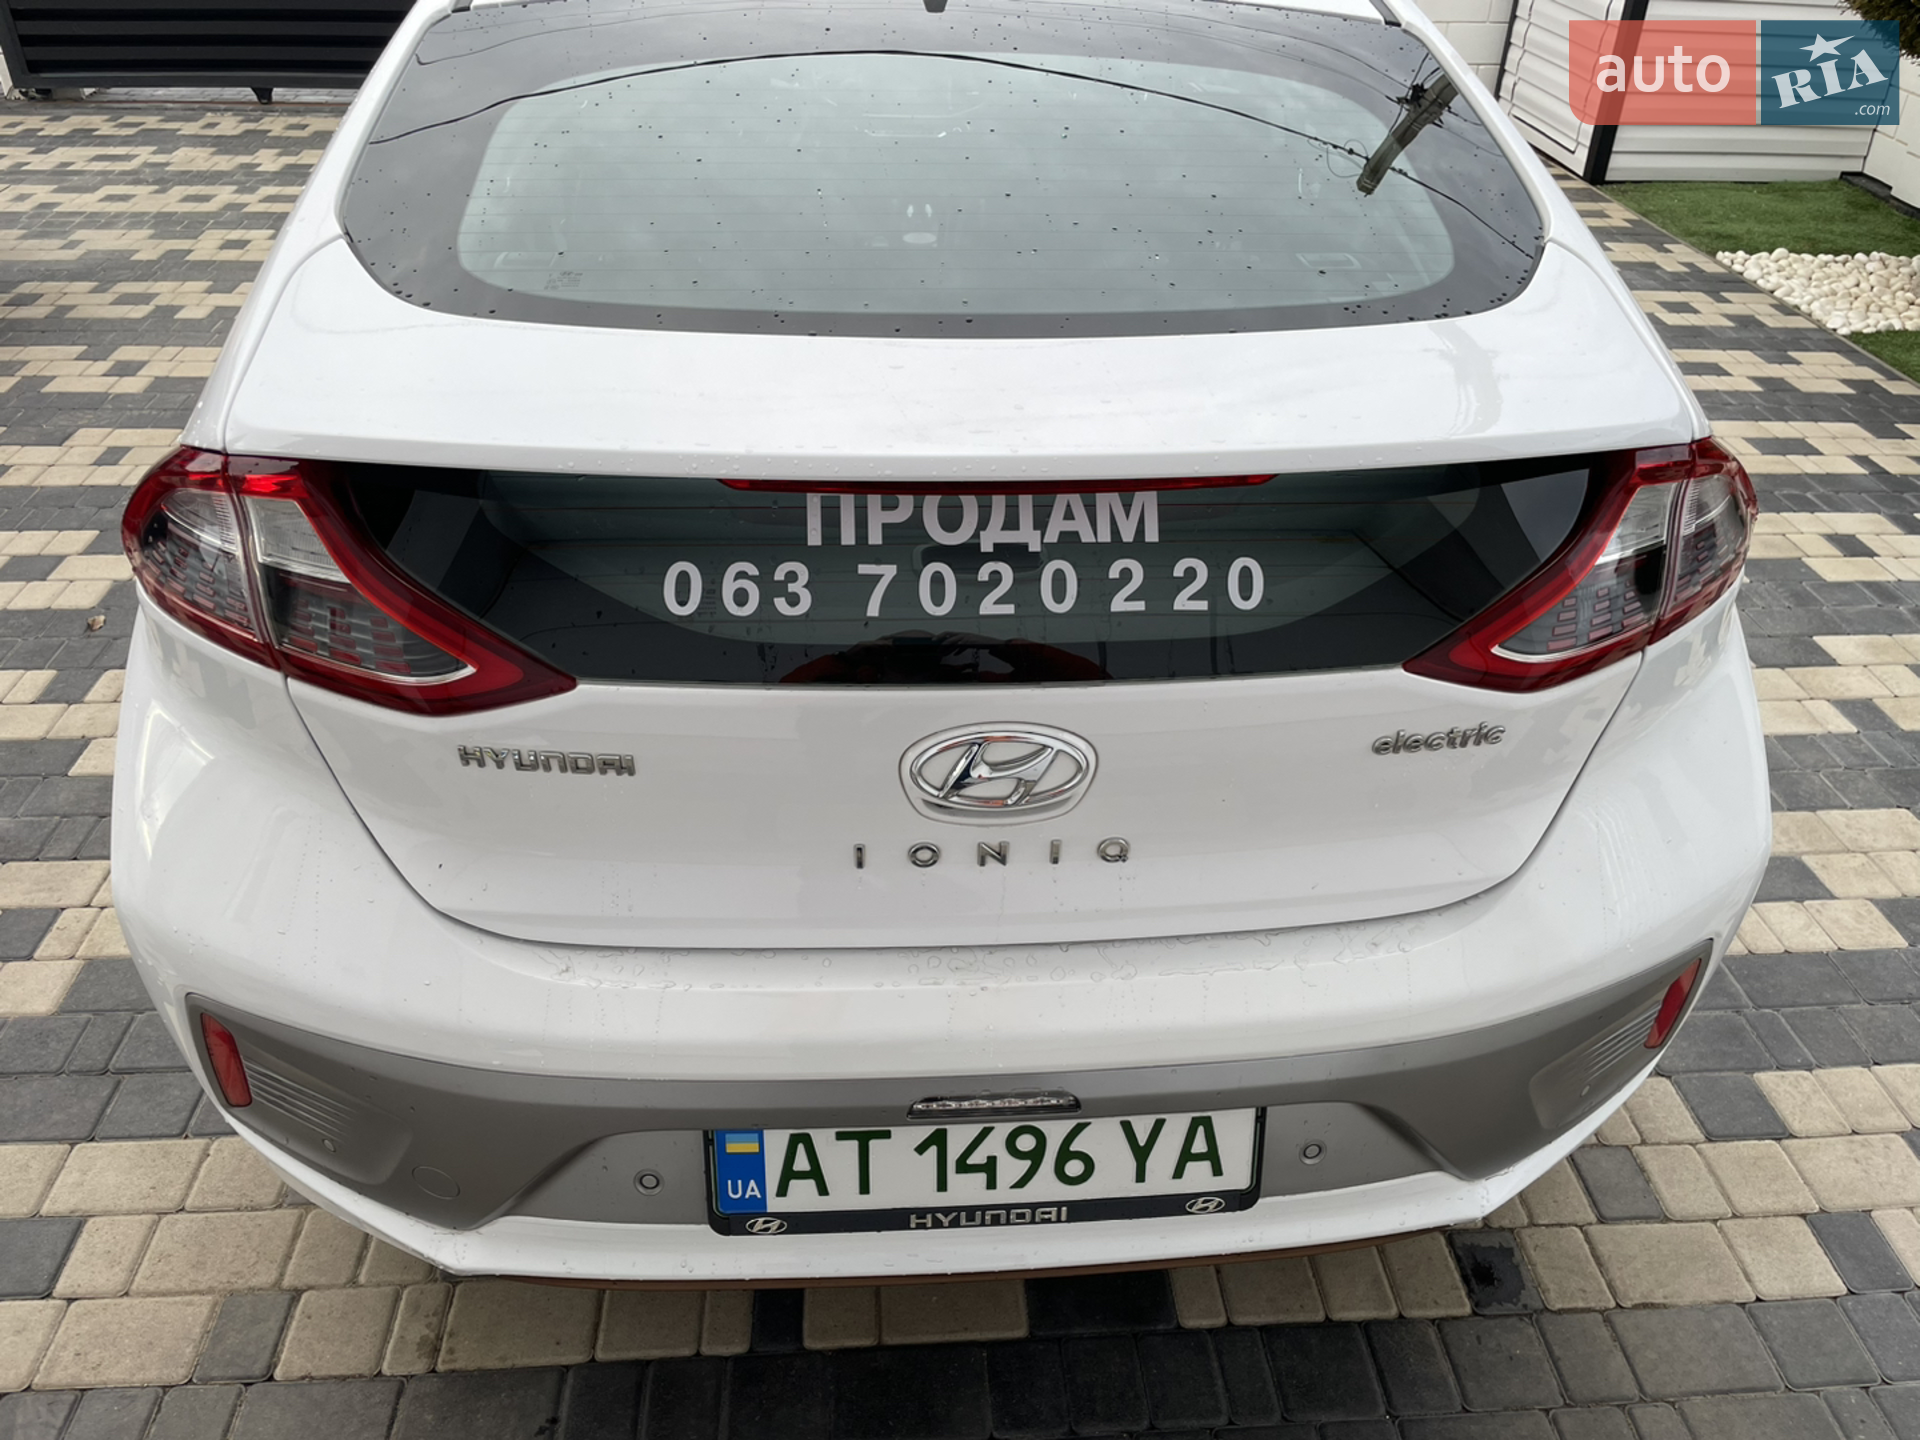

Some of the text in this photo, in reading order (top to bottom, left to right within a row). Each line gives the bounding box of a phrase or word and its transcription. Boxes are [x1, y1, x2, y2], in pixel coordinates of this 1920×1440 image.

[806, 491, 1160, 552] ПРОДАМ
[663, 560, 813, 617] 063
[857, 556, 1265, 617] 7020220
[1371, 721, 1506, 755] electric
[457, 745, 637, 776] HYUNDAI
[853, 836, 1131, 869] IONIQ
[775, 1115, 1224, 1198] AT 1496 YA
[727, 1179, 761, 1200] UA
[909, 1206, 1068, 1229] HYUNDAI
